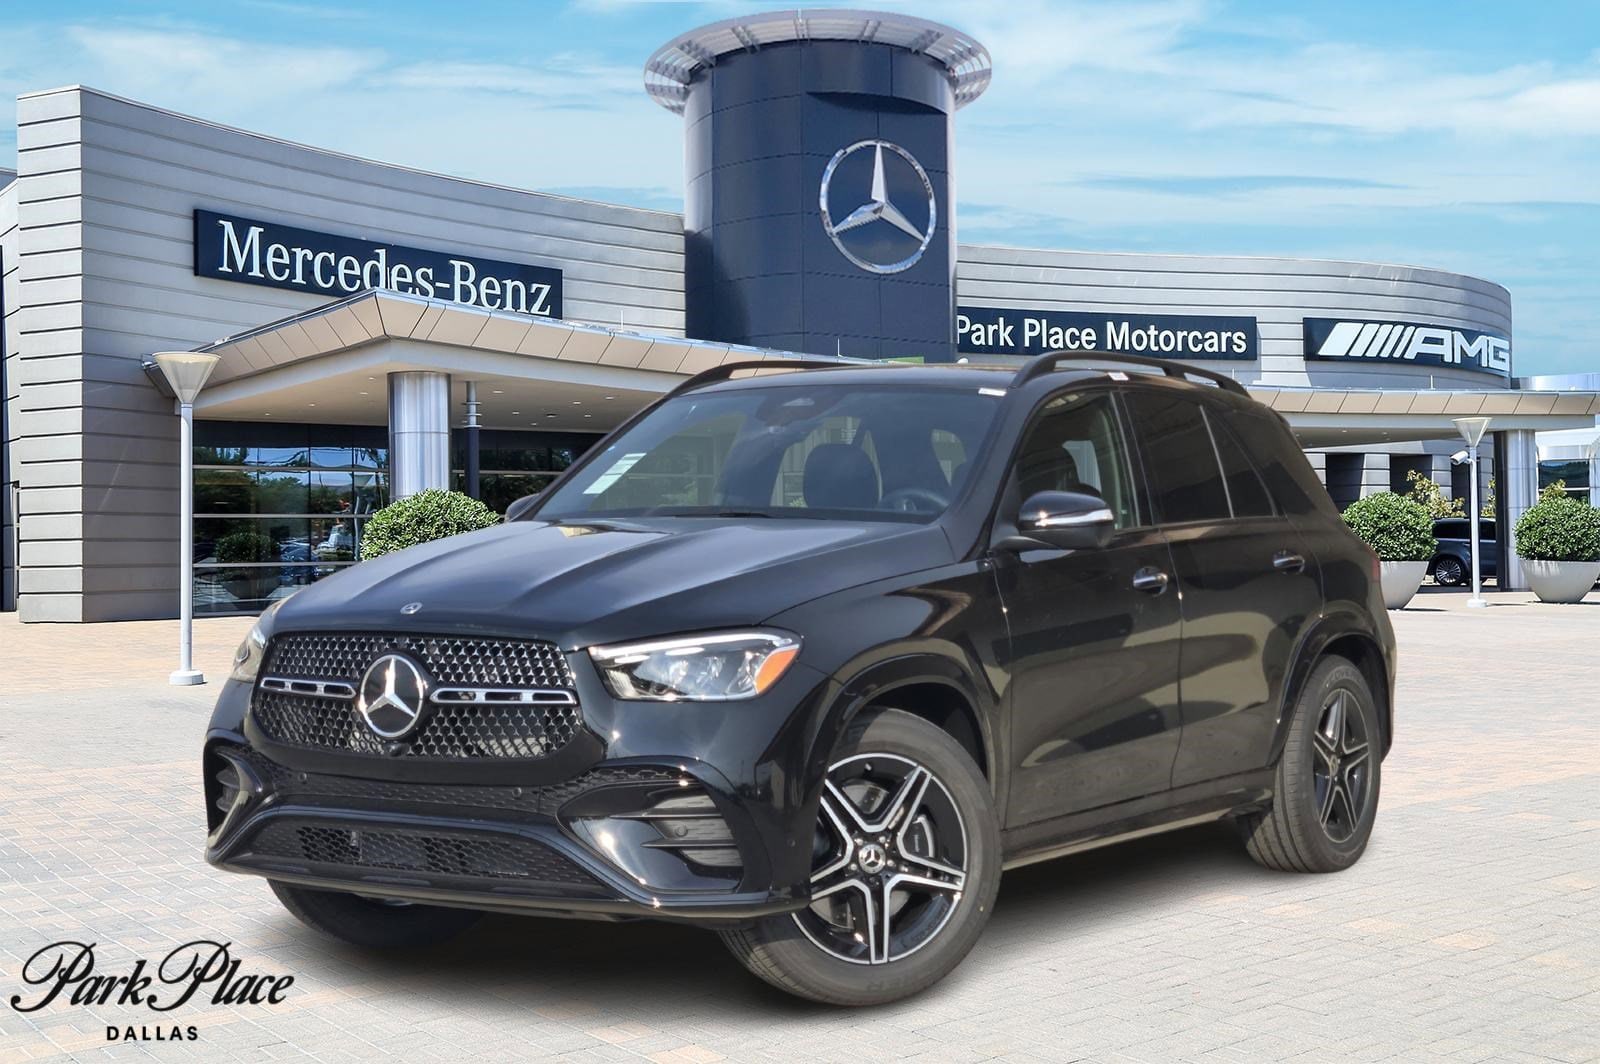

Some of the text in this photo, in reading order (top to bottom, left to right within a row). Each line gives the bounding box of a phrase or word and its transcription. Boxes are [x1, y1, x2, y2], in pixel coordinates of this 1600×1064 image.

[218, 219, 551, 316] Mercedes-Benz
[957, 314, 1248, 354] Park Place Motorcars
[1403, 327, 1509, 372] AMG
